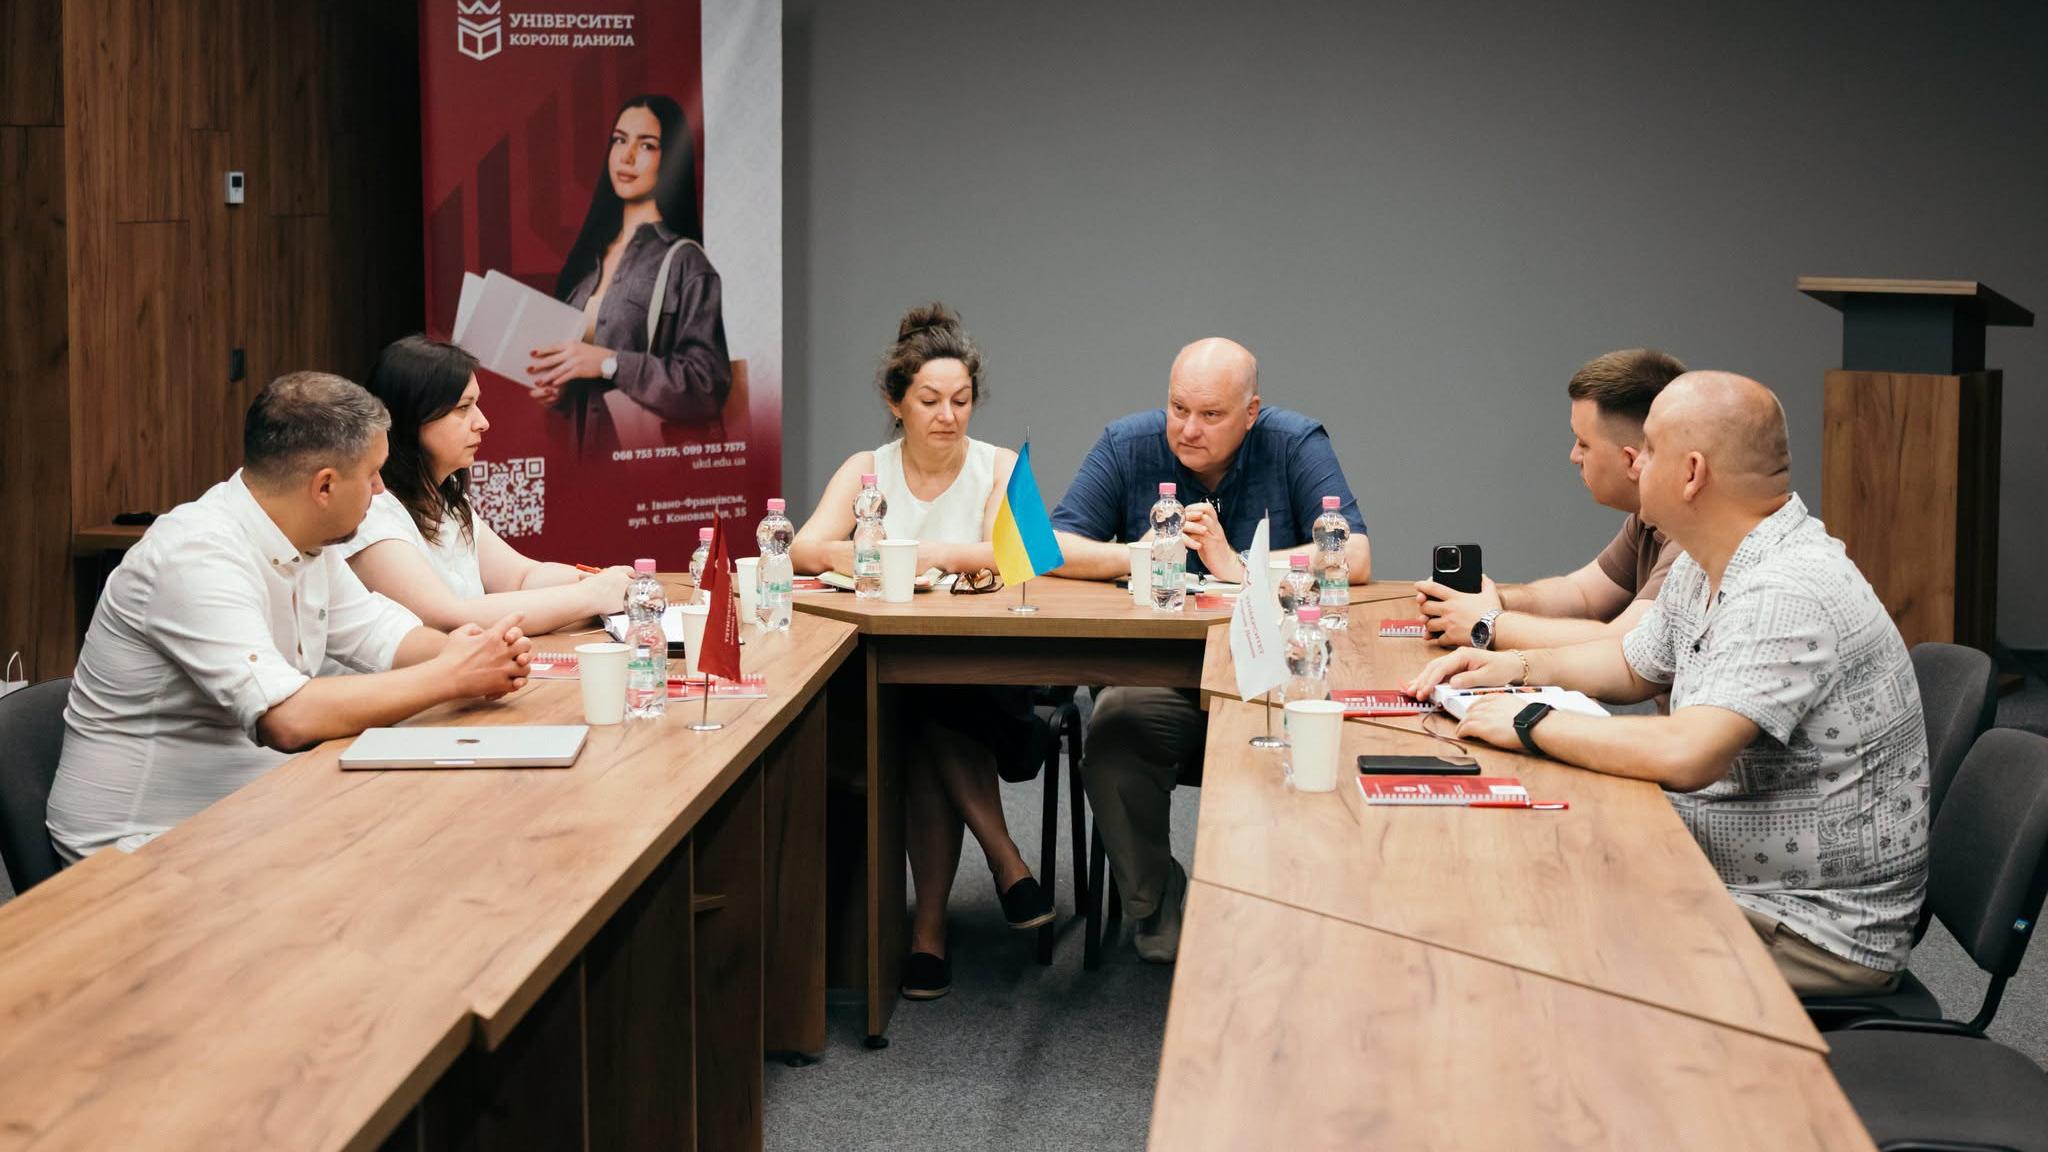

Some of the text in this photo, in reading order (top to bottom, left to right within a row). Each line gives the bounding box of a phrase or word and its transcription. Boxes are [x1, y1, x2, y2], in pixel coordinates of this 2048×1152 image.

[509, 13, 635, 29] УНІВЕРСИТЕТ
[509, 34, 635, 48] КОРОЛЯ ДАНИЛА
[612, 450, 633, 461] 068
[635, 449, 653, 460] 755
[682, 444, 702, 456] 099
[704, 443, 722, 454] 755
[724, 441, 746, 452] 7575
